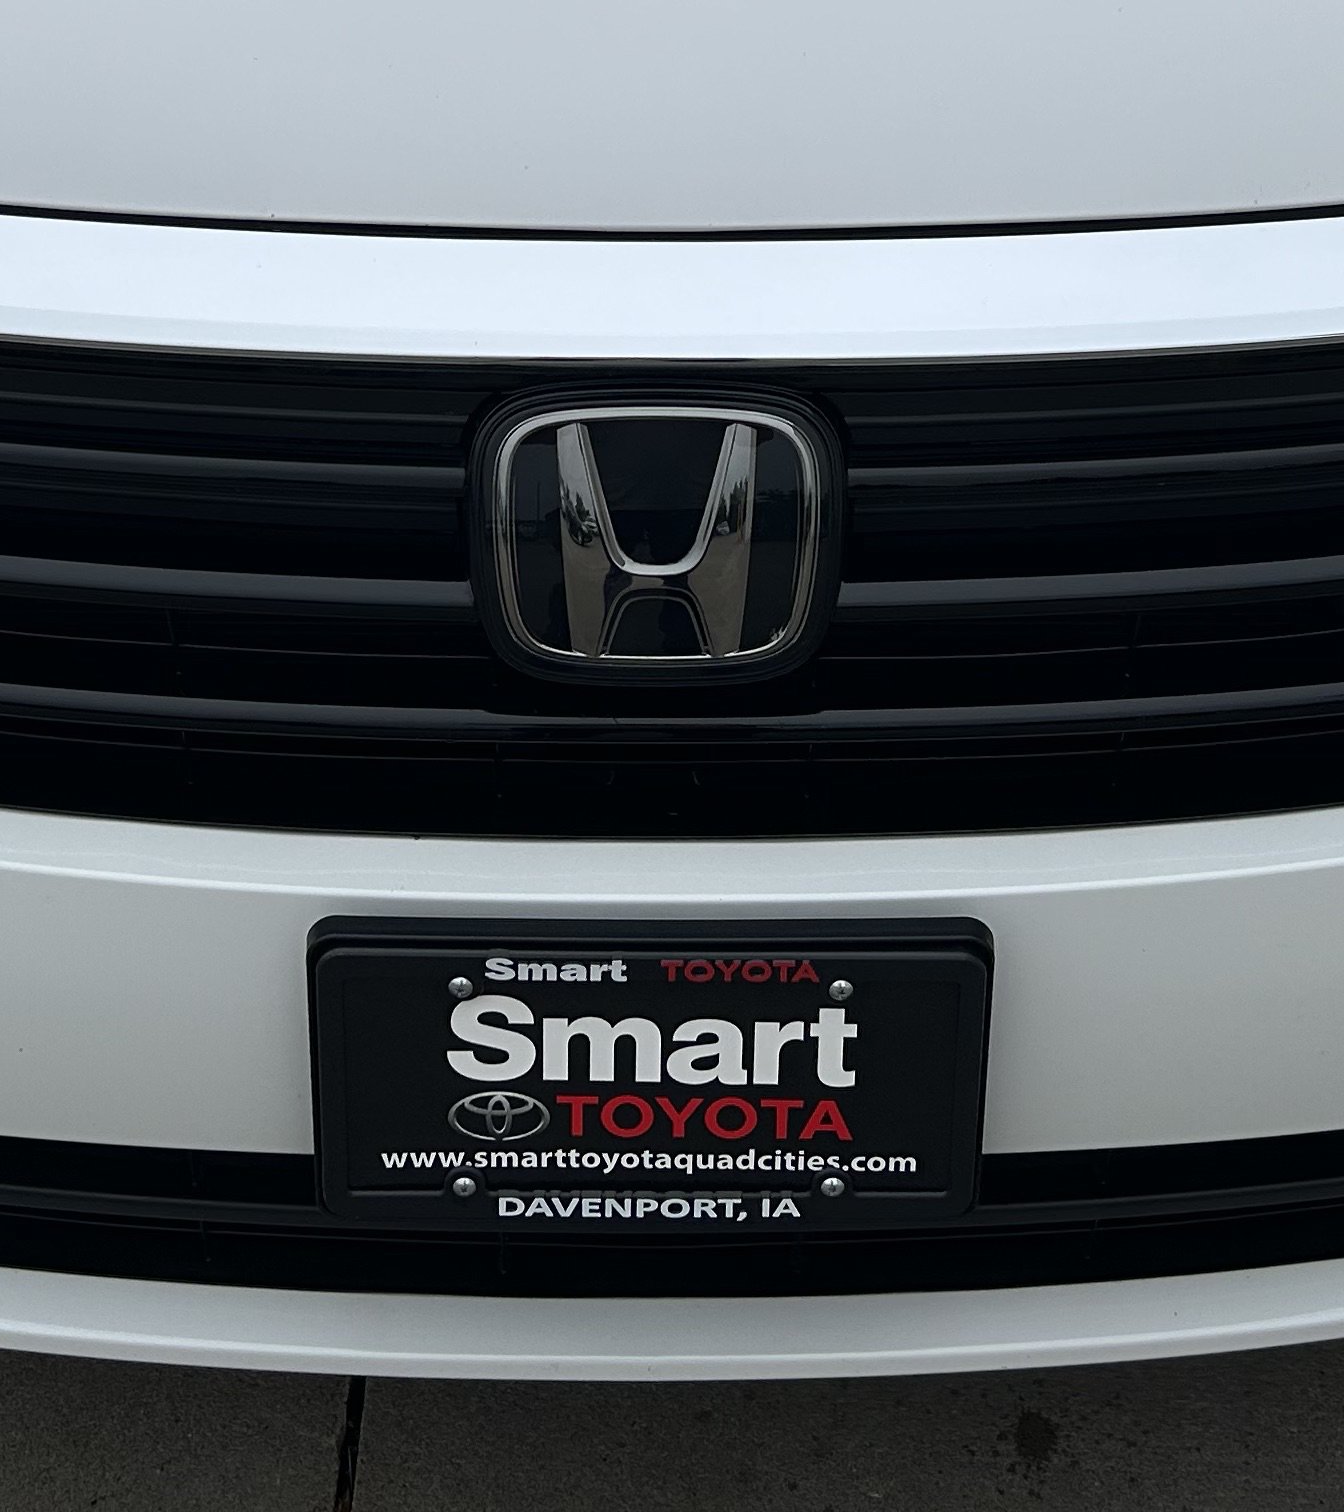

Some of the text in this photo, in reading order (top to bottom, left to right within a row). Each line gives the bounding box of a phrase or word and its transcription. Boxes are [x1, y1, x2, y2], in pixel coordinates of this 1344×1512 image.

[484, 957, 821, 984] Smart TOYOTA
[446, 994, 858, 1088] Smart
[556, 1094, 853, 1141] TOYOTA
[381, 1148, 917, 1175] www.smarttoyotaquadcities.com
[498, 1196, 802, 1222] DAVENPORT, IA
